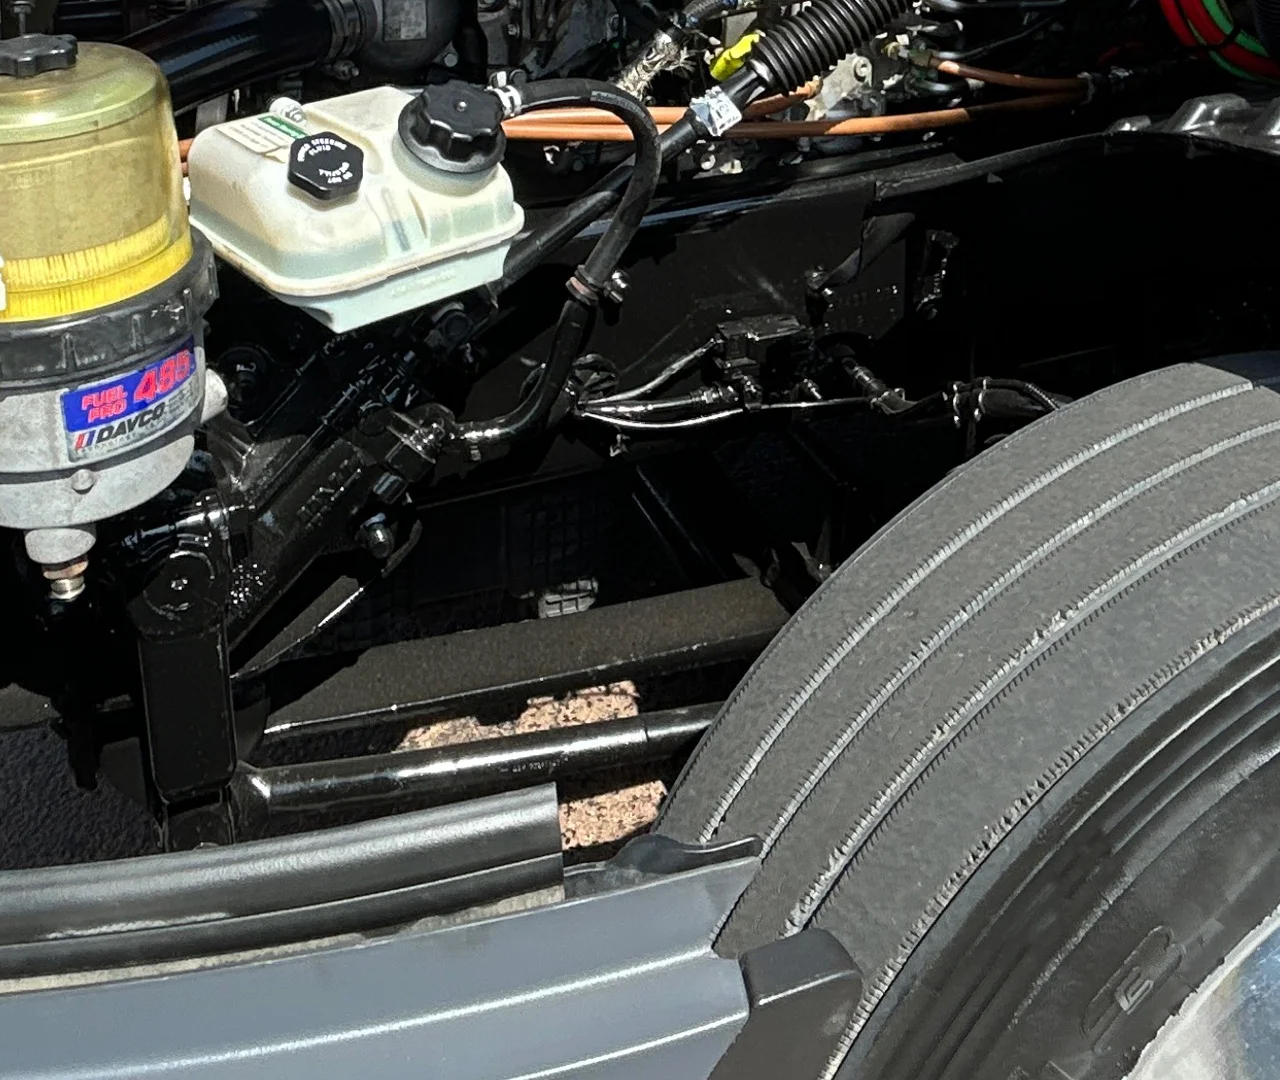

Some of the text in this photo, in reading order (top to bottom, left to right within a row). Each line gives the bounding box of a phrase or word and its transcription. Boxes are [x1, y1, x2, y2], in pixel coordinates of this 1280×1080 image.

[81, 384, 128, 411] FUEL
[87, 398, 127, 424] PRO
[96, 401, 166, 444] DAVCO
